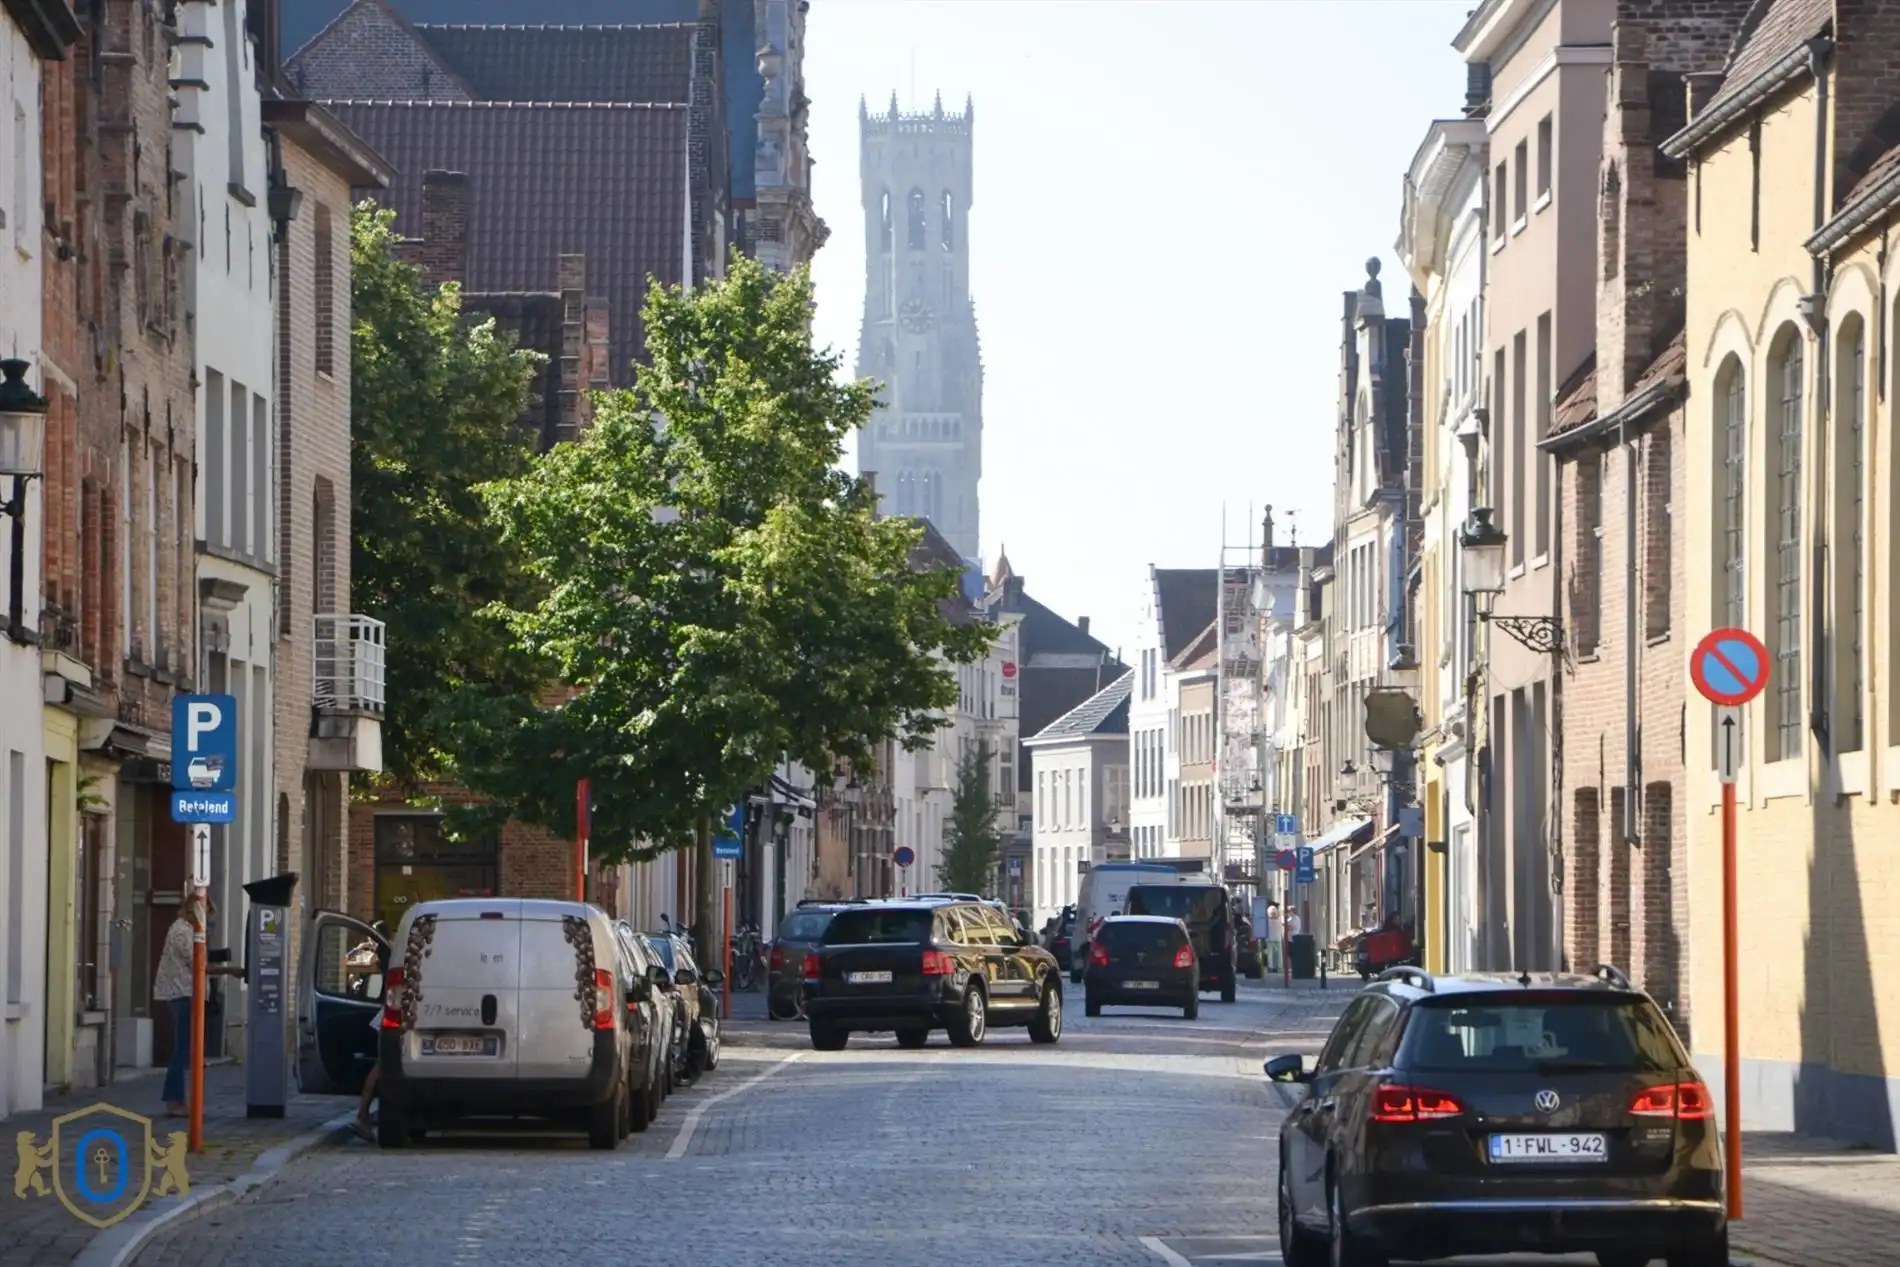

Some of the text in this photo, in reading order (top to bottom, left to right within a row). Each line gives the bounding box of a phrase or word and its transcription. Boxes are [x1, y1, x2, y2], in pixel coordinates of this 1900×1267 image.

[187, 702, 222, 751] P
[1299, 849, 1309, 863] P
[444, 1004, 480, 1018] service
